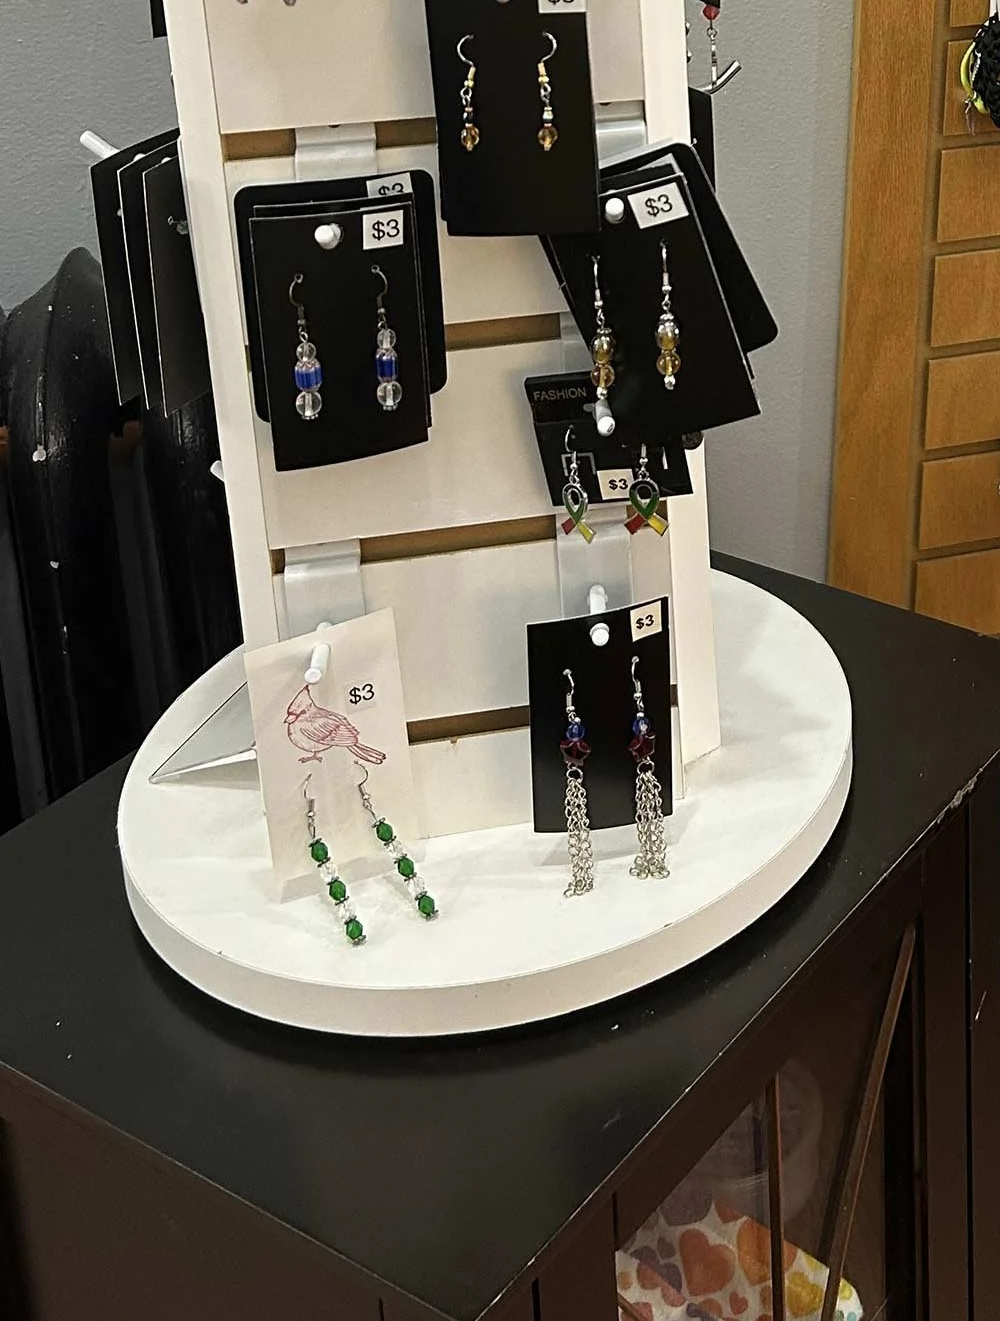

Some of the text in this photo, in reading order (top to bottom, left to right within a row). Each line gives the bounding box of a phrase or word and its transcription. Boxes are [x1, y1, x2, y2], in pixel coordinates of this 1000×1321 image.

[644, 194, 673, 217] $3
[372, 219, 400, 241] $3
[533, 387, 588, 401] FASHION
[608, 479, 629, 491] $3
[635, 614, 655, 630] $3
[349, 683, 375, 705] $3
